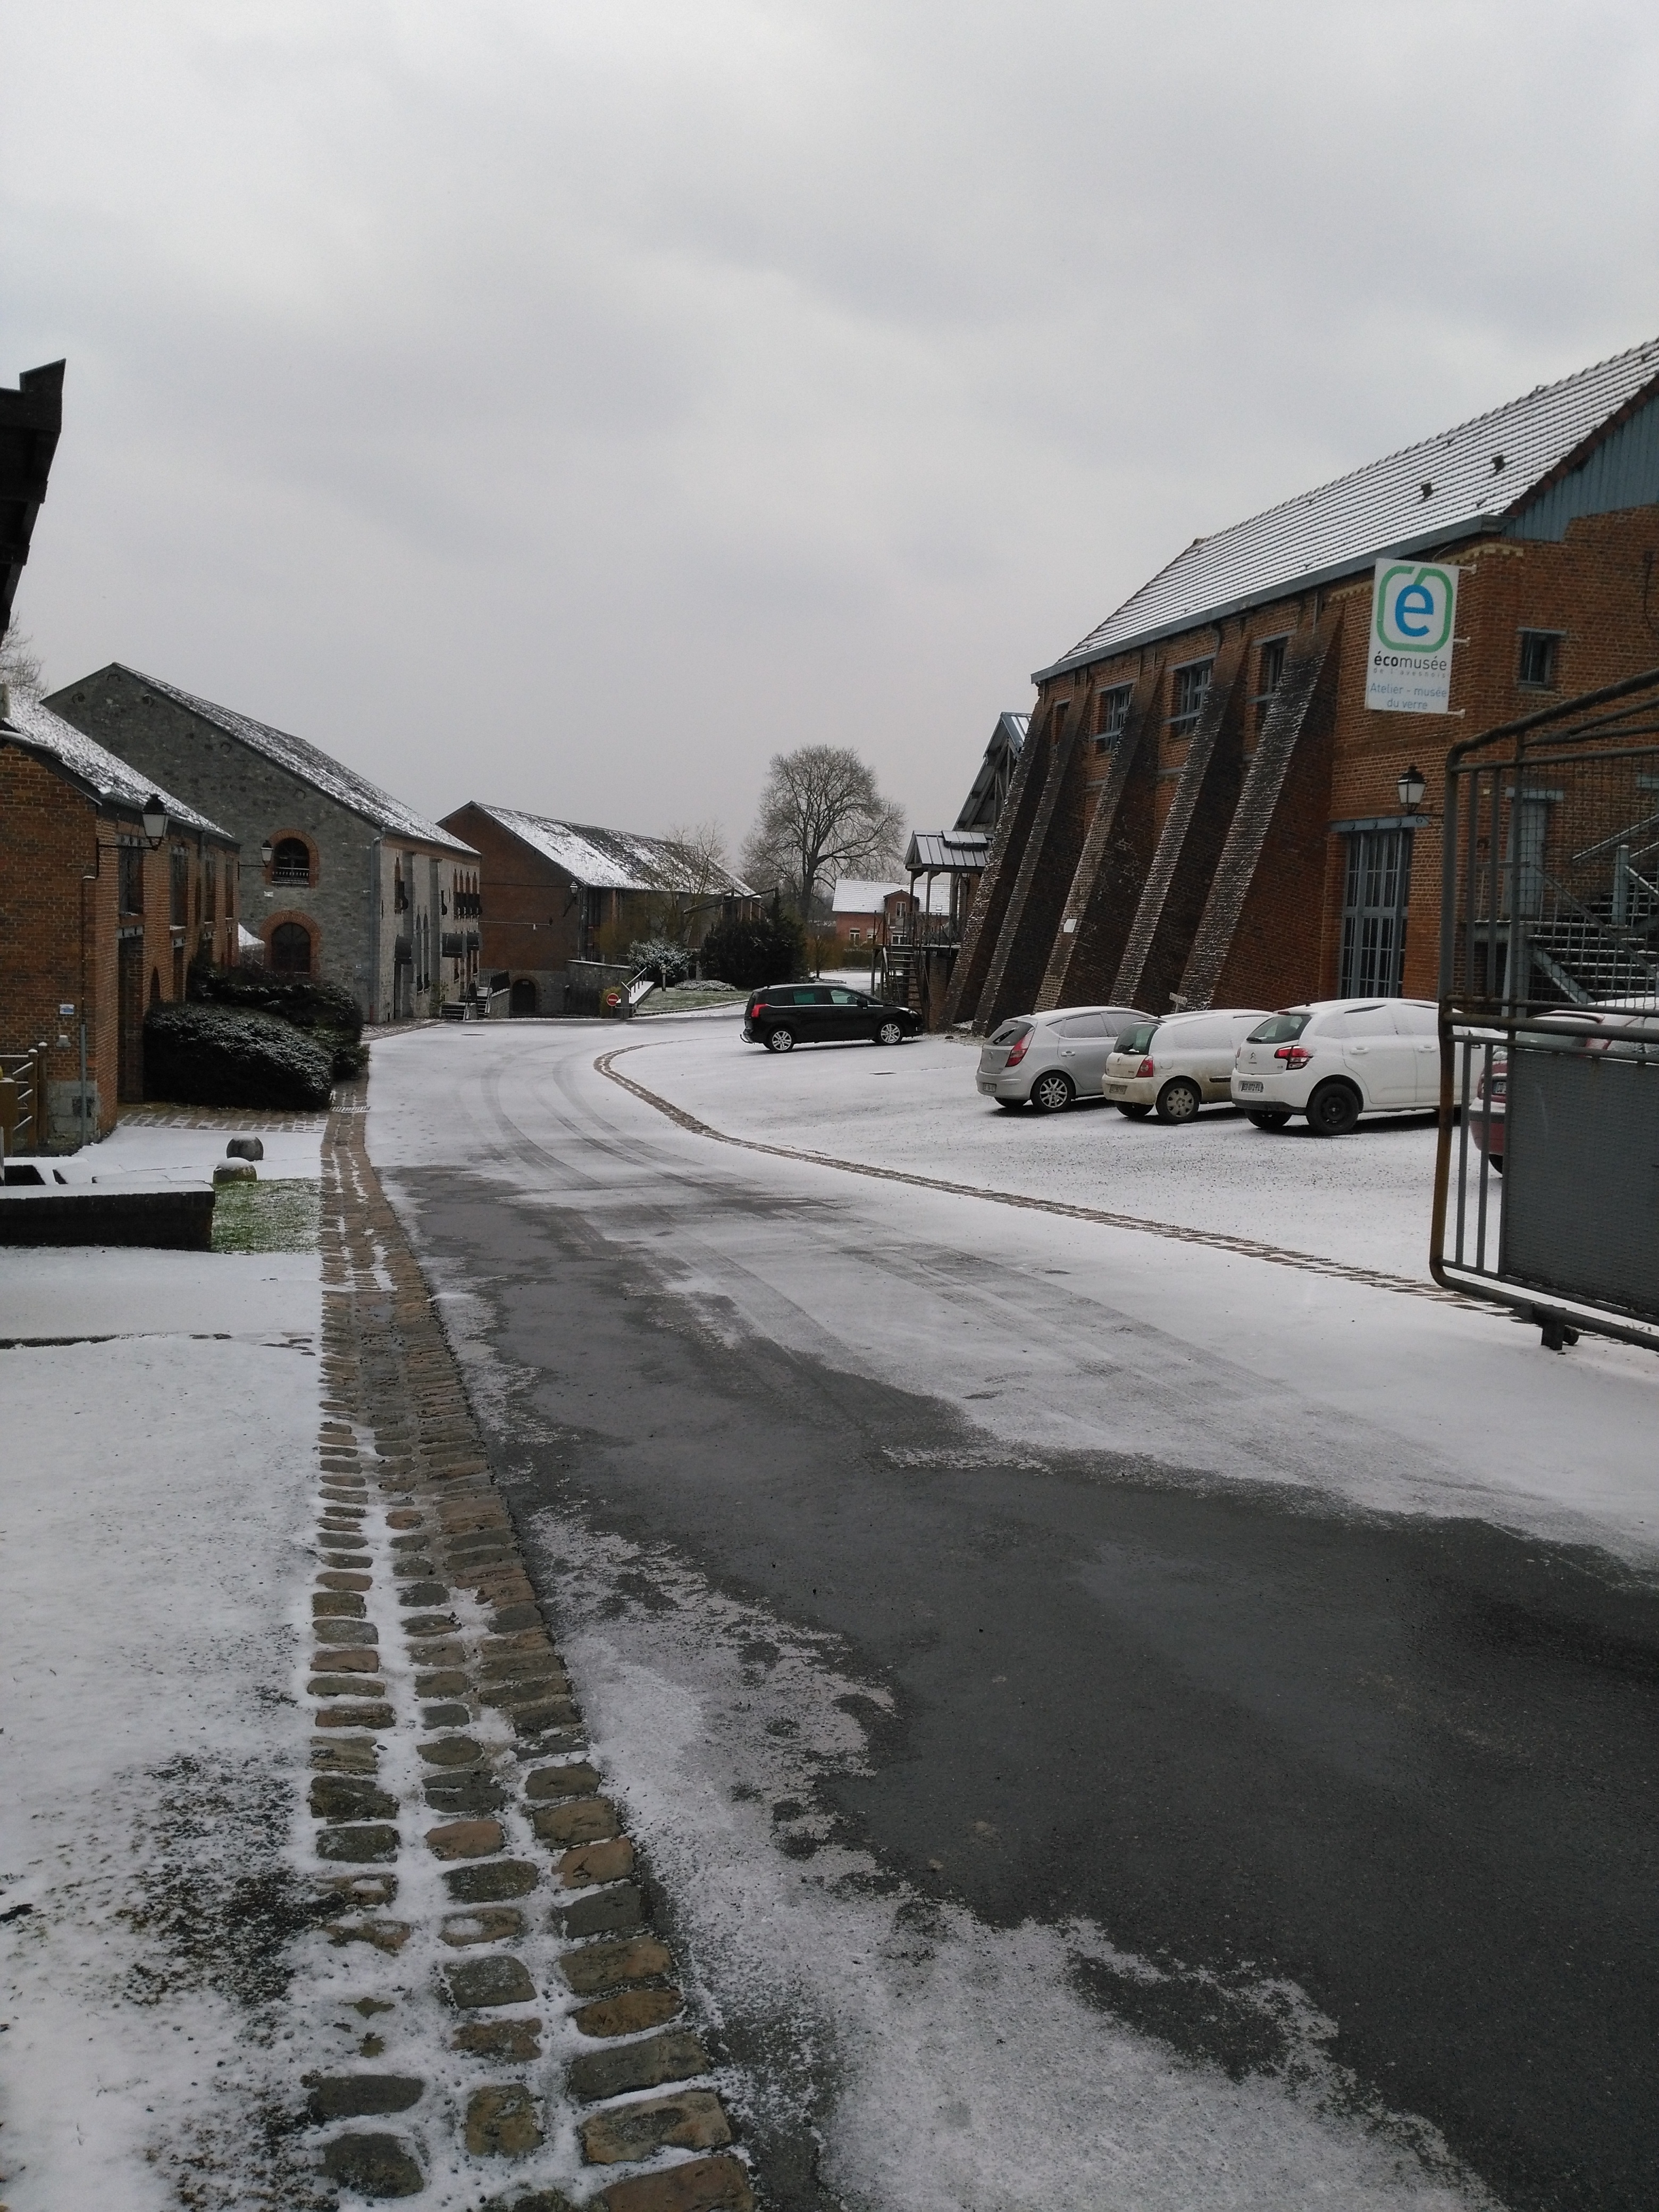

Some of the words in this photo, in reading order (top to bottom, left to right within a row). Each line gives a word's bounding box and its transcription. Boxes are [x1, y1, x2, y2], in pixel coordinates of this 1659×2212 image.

[1374, 650, 1447, 671] écomusée
[1370, 683, 1404, 694] Atelier
[1414, 686, 1447, 698] musée
[1387, 698, 1400, 708] du
[1402, 700, 1428, 710] verre
